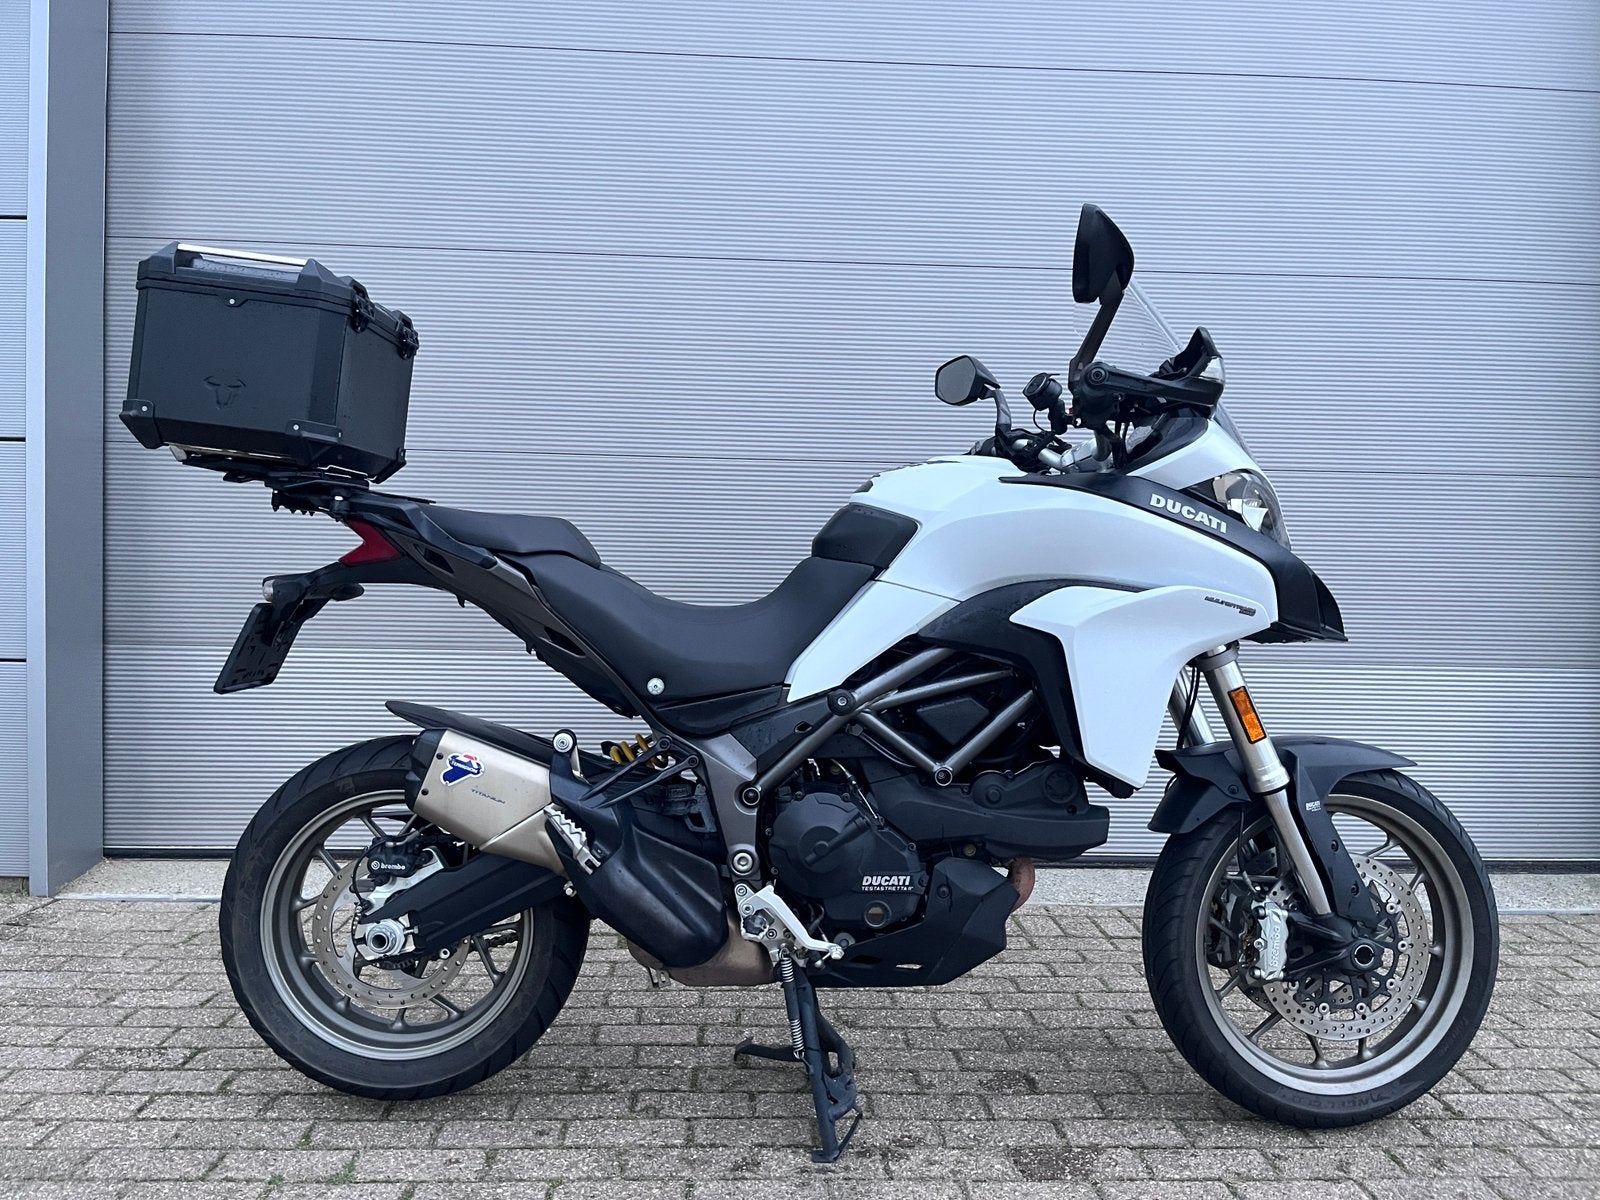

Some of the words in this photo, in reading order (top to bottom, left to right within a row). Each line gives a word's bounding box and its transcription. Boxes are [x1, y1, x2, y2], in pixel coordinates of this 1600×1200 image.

[1149, 493, 1227, 534] DUCATI
[380, 862, 406, 870] brembo
[862, 875, 911, 886] DUCATI
